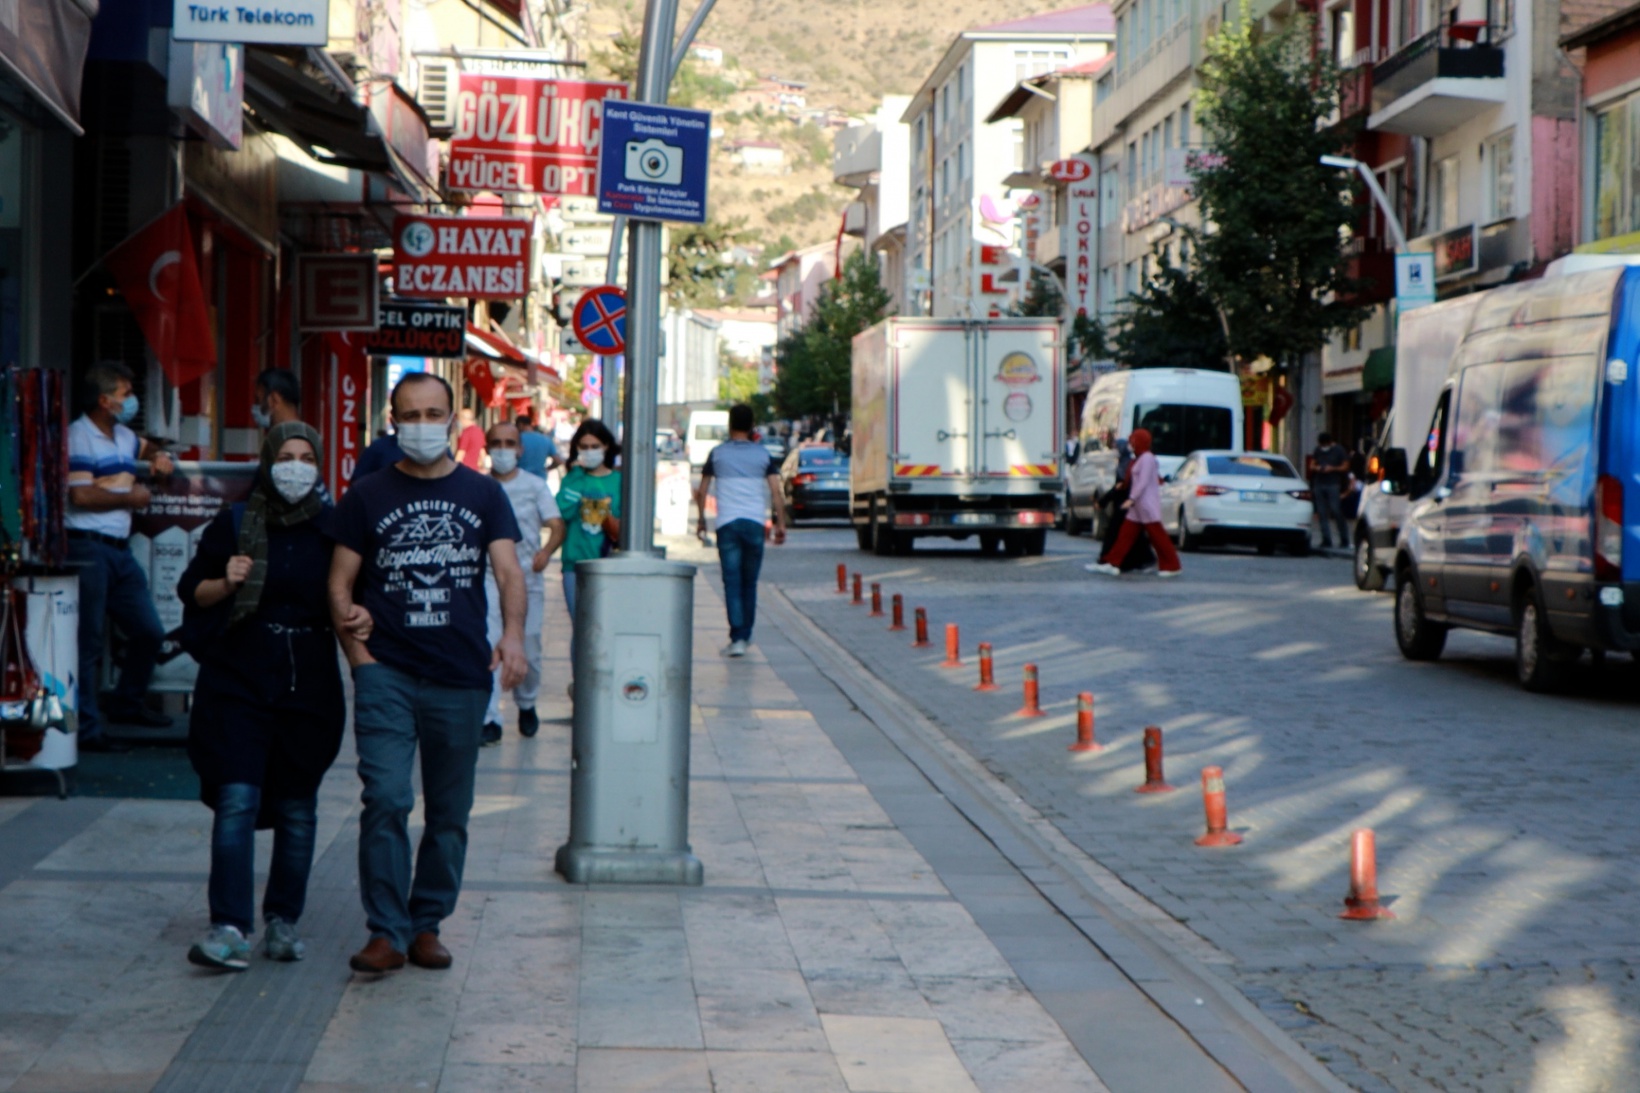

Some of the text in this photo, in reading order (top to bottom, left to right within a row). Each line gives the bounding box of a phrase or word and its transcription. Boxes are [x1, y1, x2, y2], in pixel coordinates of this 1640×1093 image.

[188, 4, 315, 28] Türk Telekom
[455, 80, 622, 155] GÖZLÜKÇ
[605, 108, 706, 130] Kent Güvenlik Yönetim
[633, 122, 679, 137] Sistemleri
[452, 154, 599, 193] YÜCEL OPT
[617, 183, 637, 193] Park
[637, 185, 659, 196] Eden
[437, 226, 526, 257] HAYAT
[398, 261, 525, 294] ECZANESİ
[305, 262, 366, 318] E
[379, 311, 462, 328] CEL OPTİK
[407, 499, 457, 513] ANCIENT
